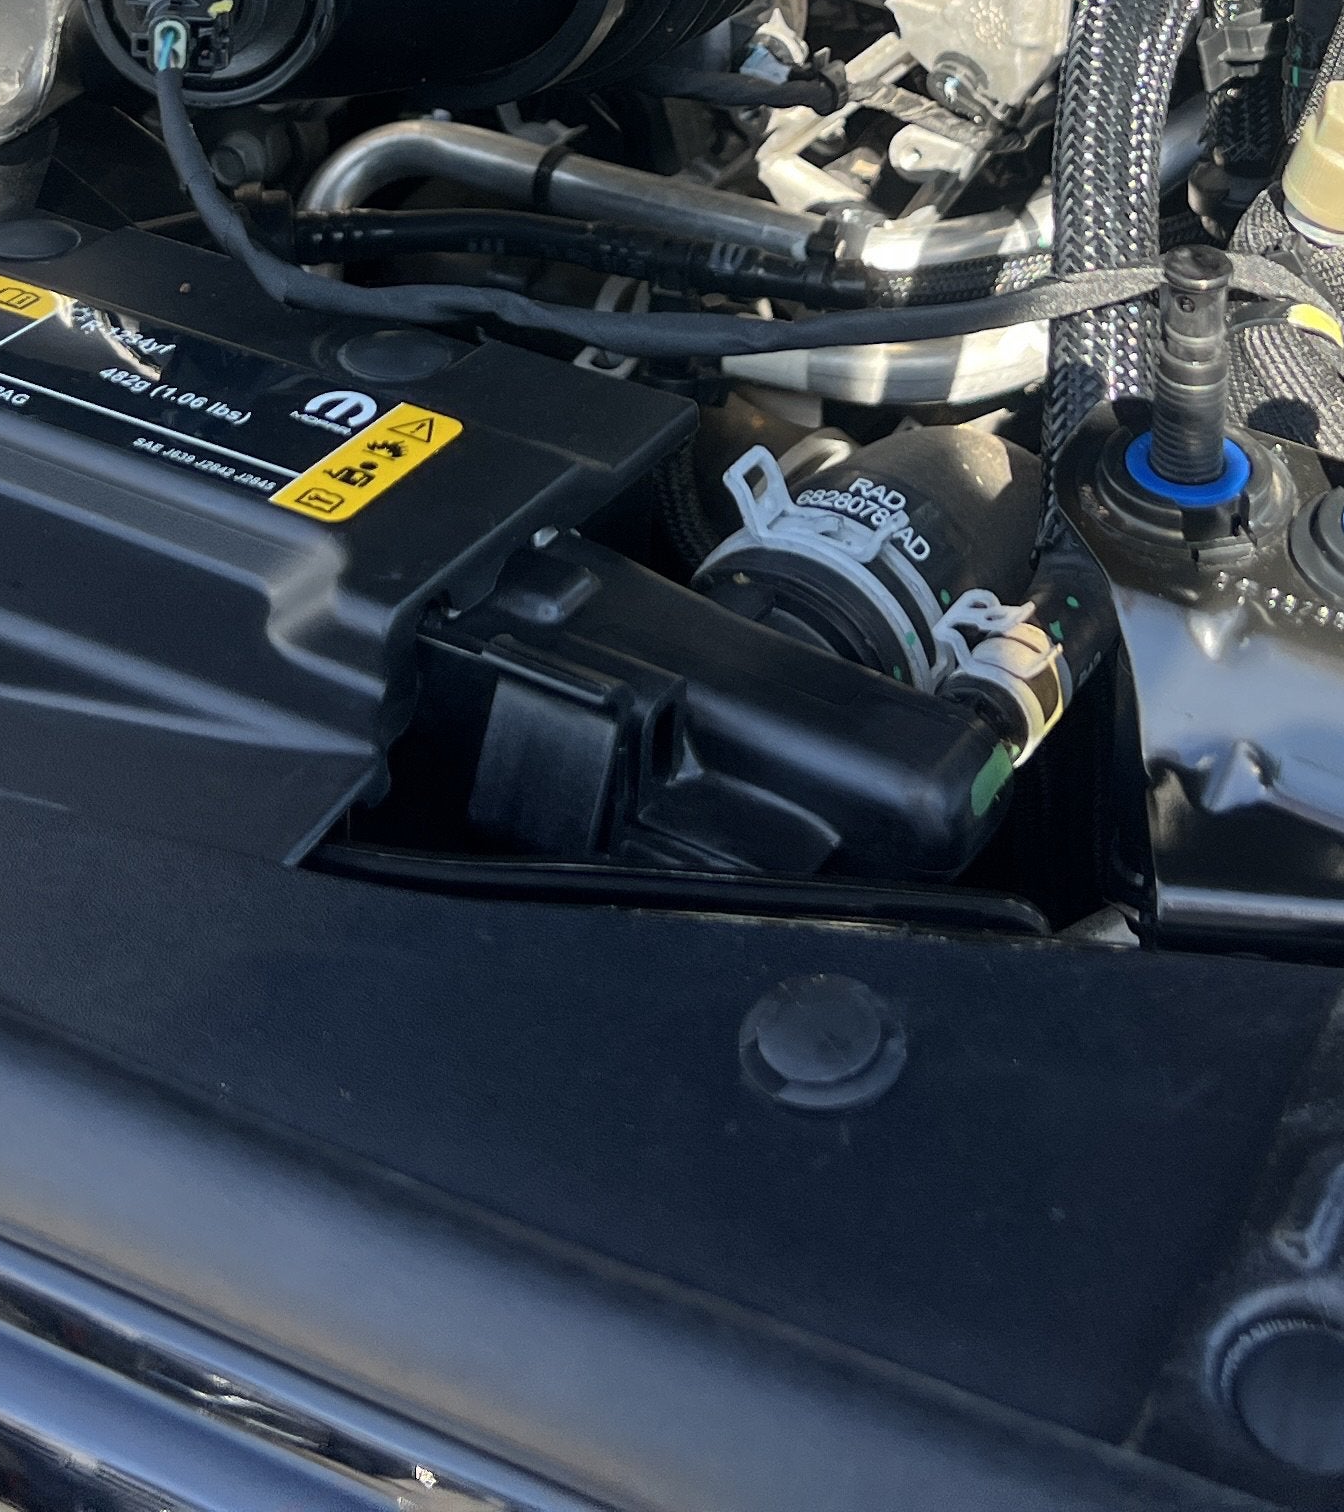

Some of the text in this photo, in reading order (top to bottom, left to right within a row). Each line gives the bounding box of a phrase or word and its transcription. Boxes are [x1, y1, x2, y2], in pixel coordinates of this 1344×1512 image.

[99, 367, 252, 426] 482g (1.06 lbs)
[131, 437, 164, 454] SAE
[162, 447, 196, 465] J639
[848, 477, 907, 512] RAD
